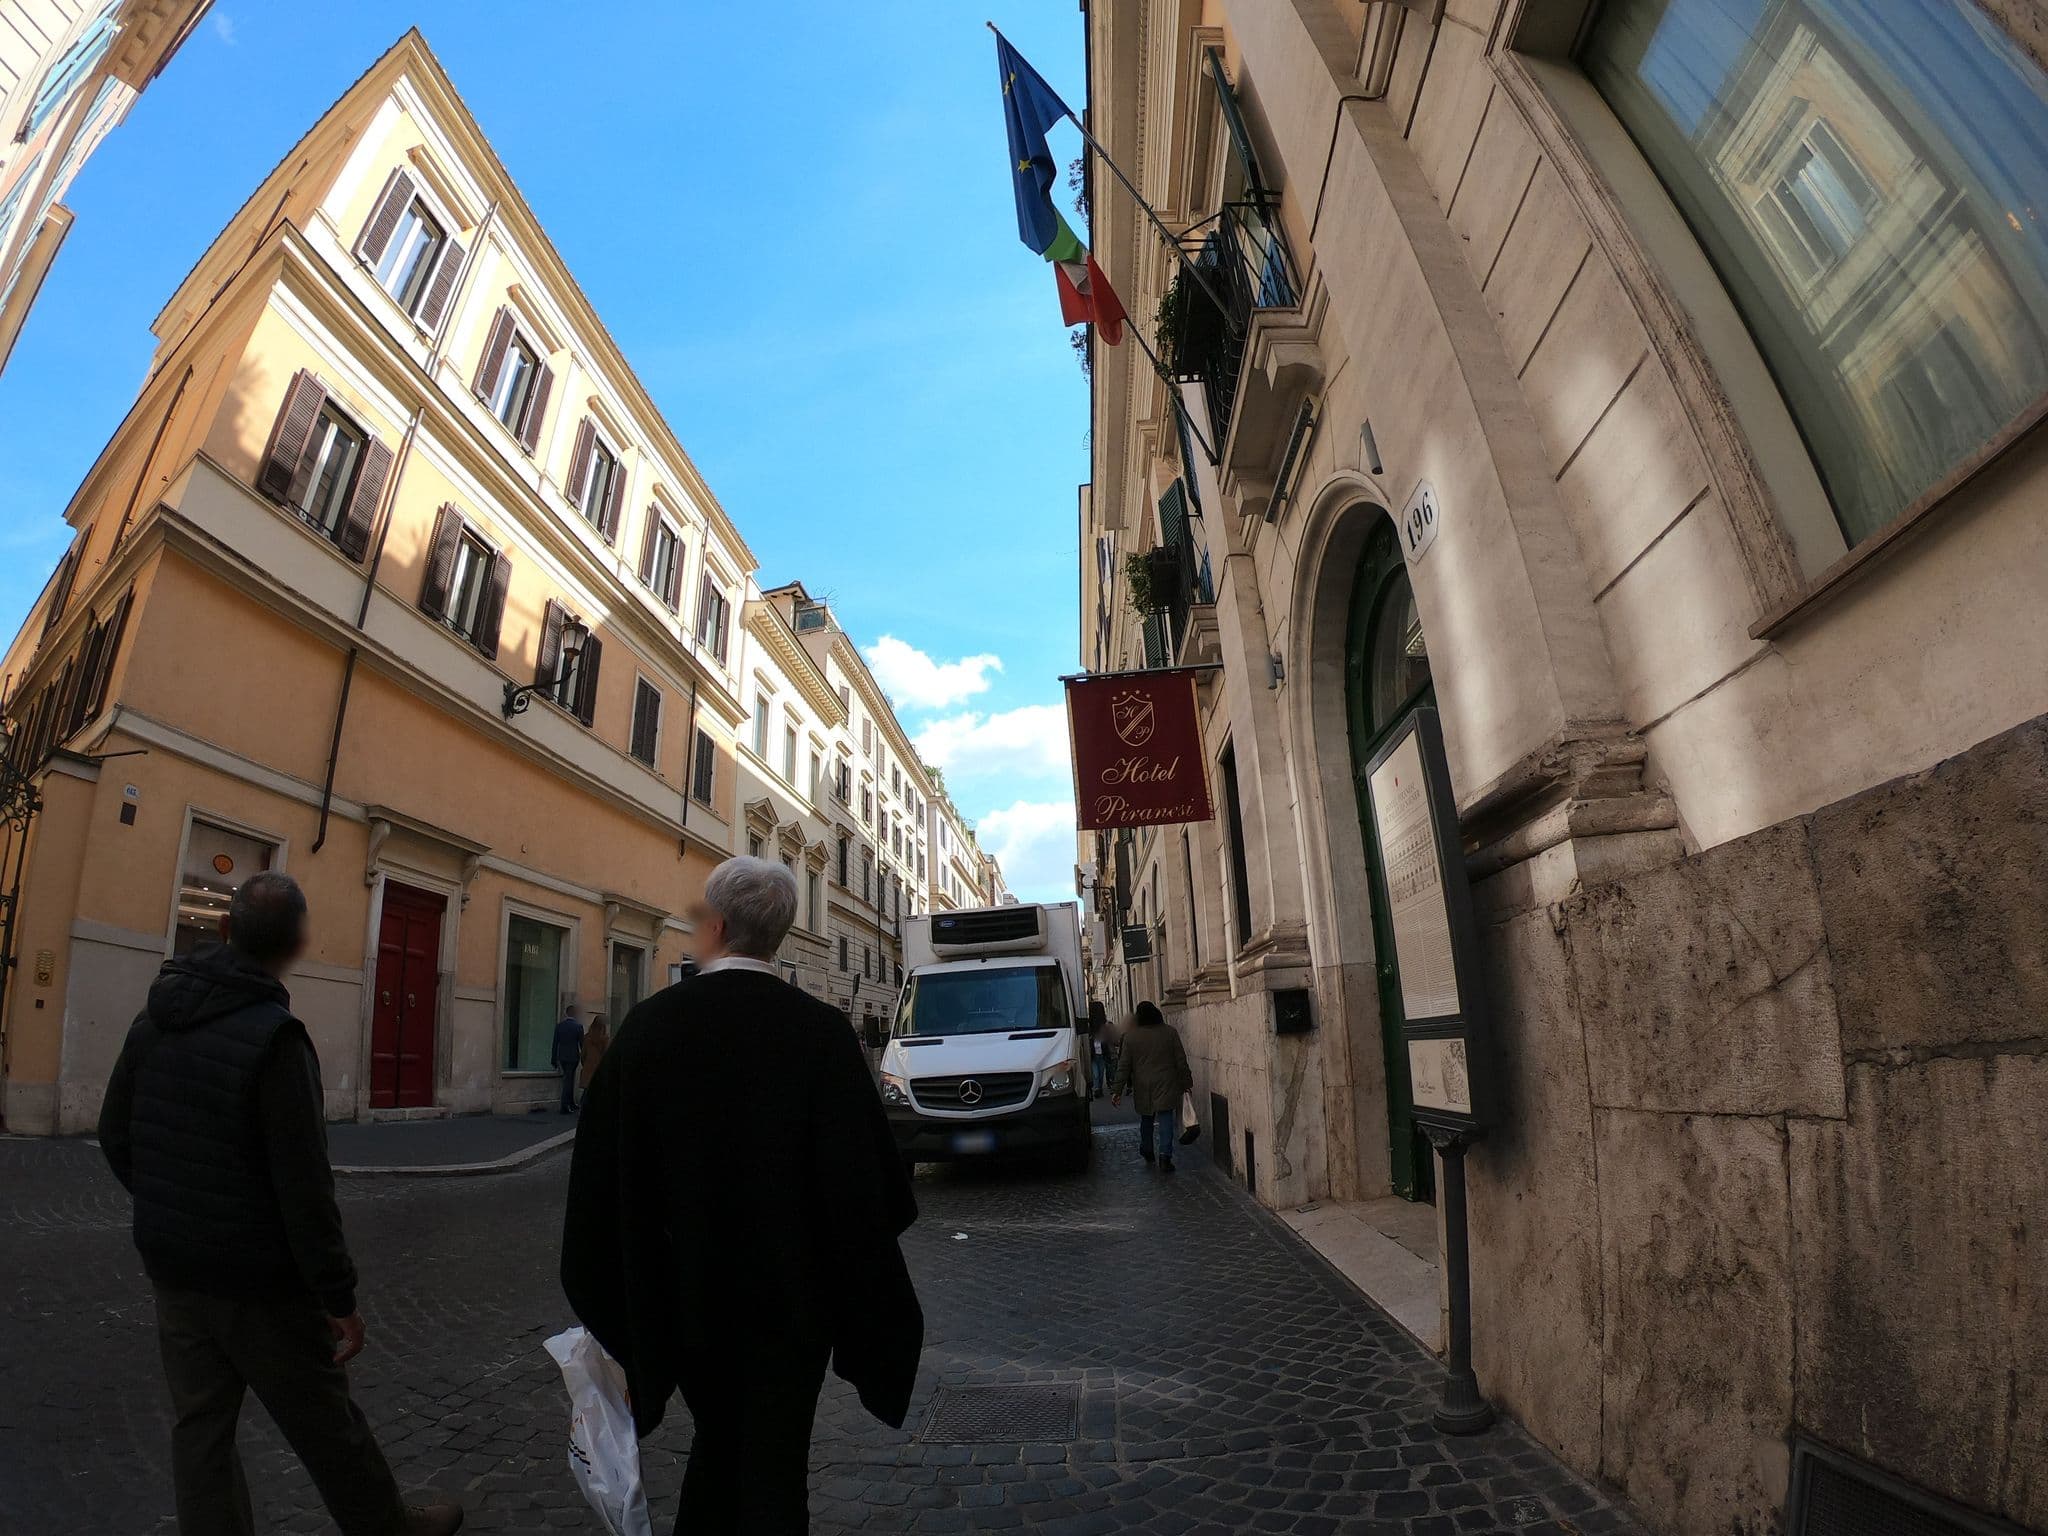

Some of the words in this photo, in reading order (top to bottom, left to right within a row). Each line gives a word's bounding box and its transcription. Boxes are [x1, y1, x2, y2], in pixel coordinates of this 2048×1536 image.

[1406, 491, 1433, 552] 196
[1101, 756, 1179, 785] Hotel
[1095, 795, 1198, 824] Piranesi
